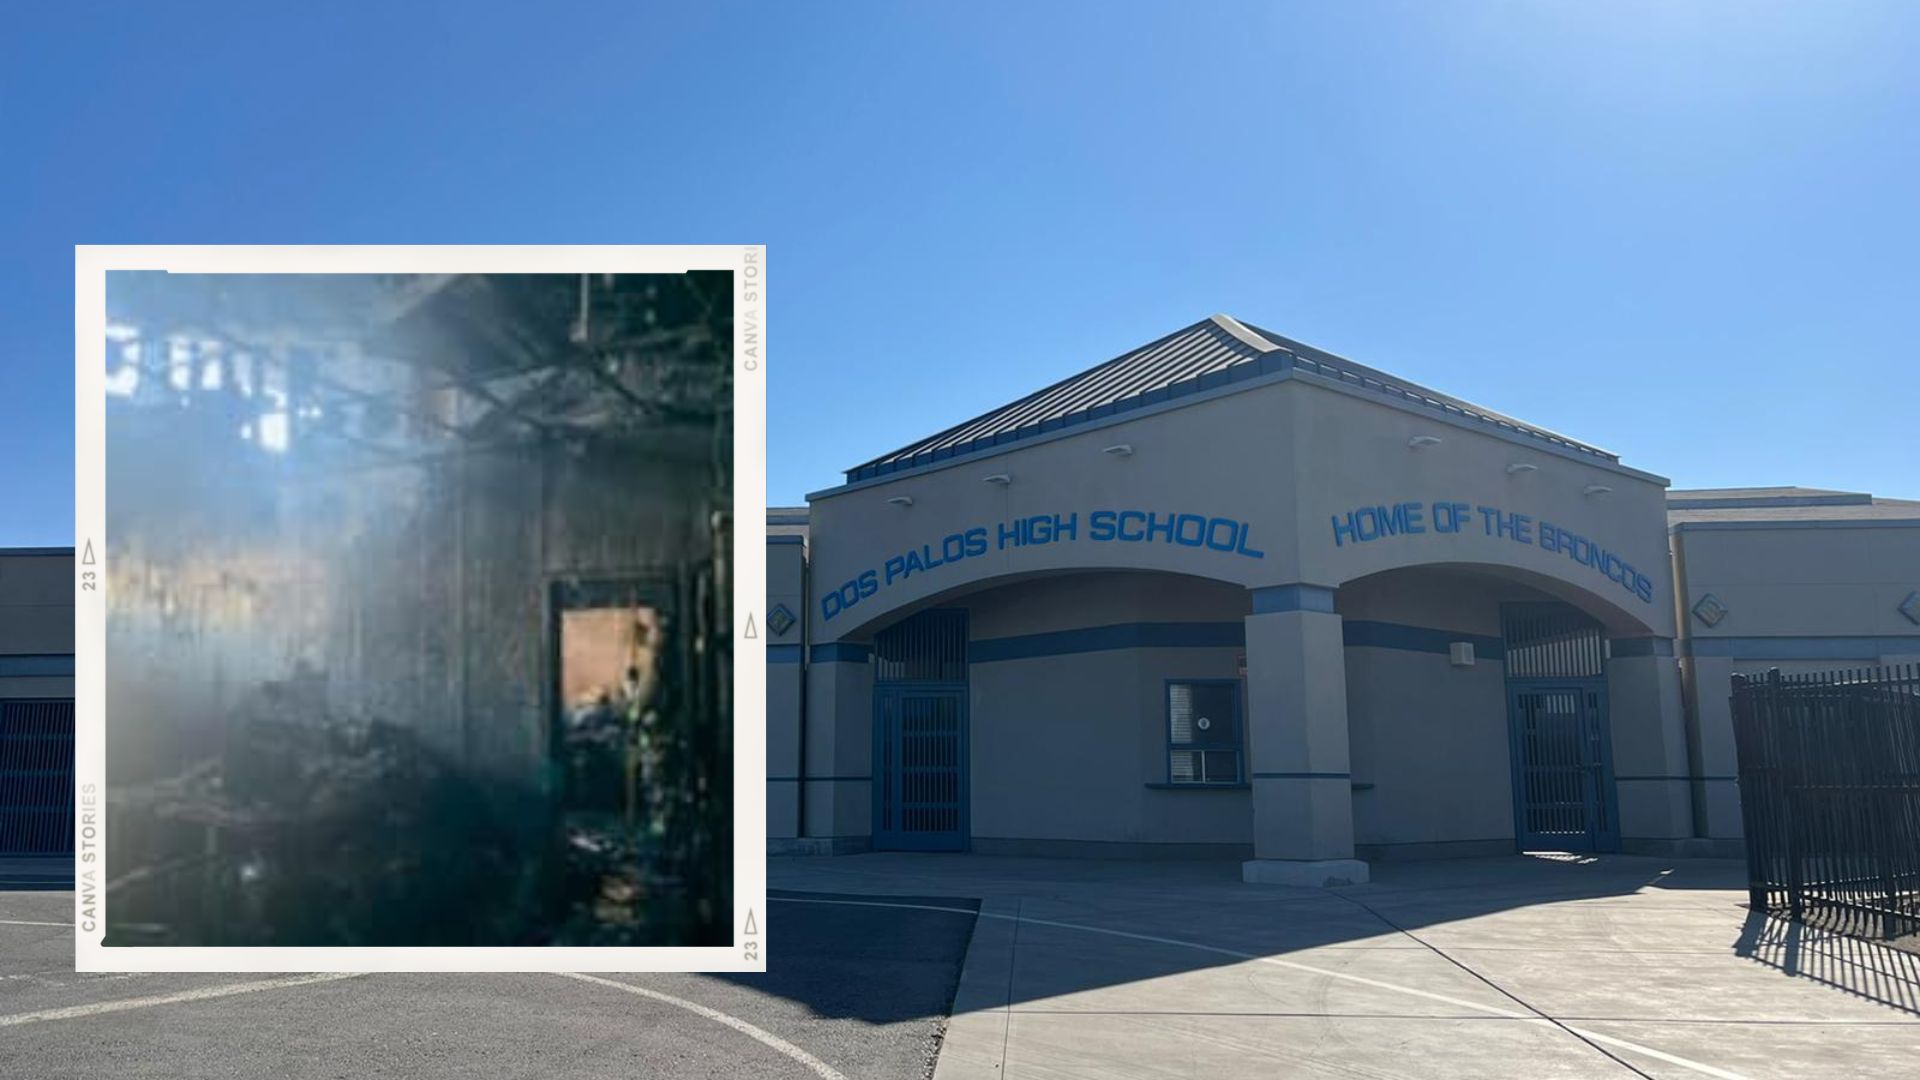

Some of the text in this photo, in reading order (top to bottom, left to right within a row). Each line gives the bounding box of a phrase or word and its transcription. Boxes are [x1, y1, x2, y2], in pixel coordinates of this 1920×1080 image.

[821, 510, 1264, 622] DOS PALOS HIGH SCHOOL
[1331, 502, 1653, 604] HOME OF THE BRONCOS
